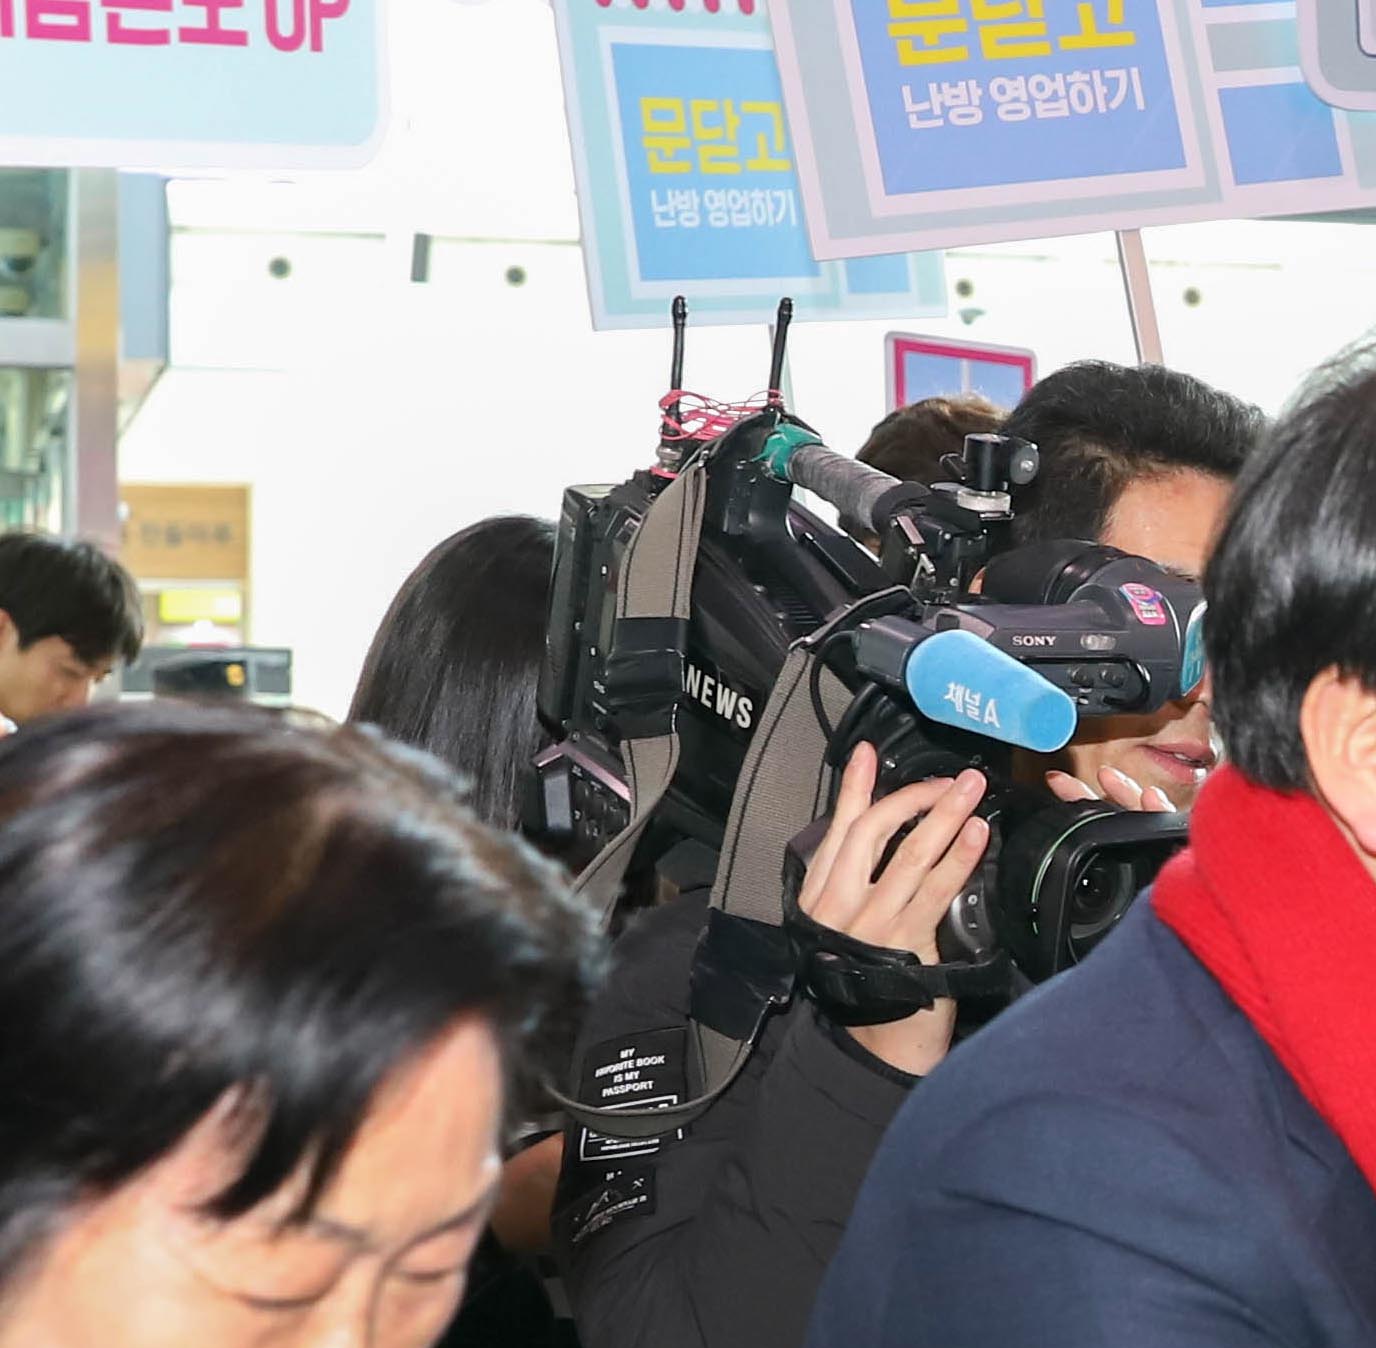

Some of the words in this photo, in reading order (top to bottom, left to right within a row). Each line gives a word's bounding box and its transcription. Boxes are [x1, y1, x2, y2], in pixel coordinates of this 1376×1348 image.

[265, 0, 350, 52] UP
[902, 78, 984, 129] 난방
[989, 66, 1146, 122] 영업하기
[639, 97, 792, 175] 문닫고
[651, 188, 702, 228] 난방
[704, 188, 798, 228] 영업하기
[1012, 635, 1057, 647] SONY
[686, 663, 753, 729] NEWS
[943, 681, 1001, 729] 채널A
[620, 1048, 636, 1059] MY
[636, 1055, 666, 1067] BOOK
[602, 1080, 655, 1098] PASSPORT
[613, 1073, 623, 1083] IS
[625, 1070, 640, 1081] MY
